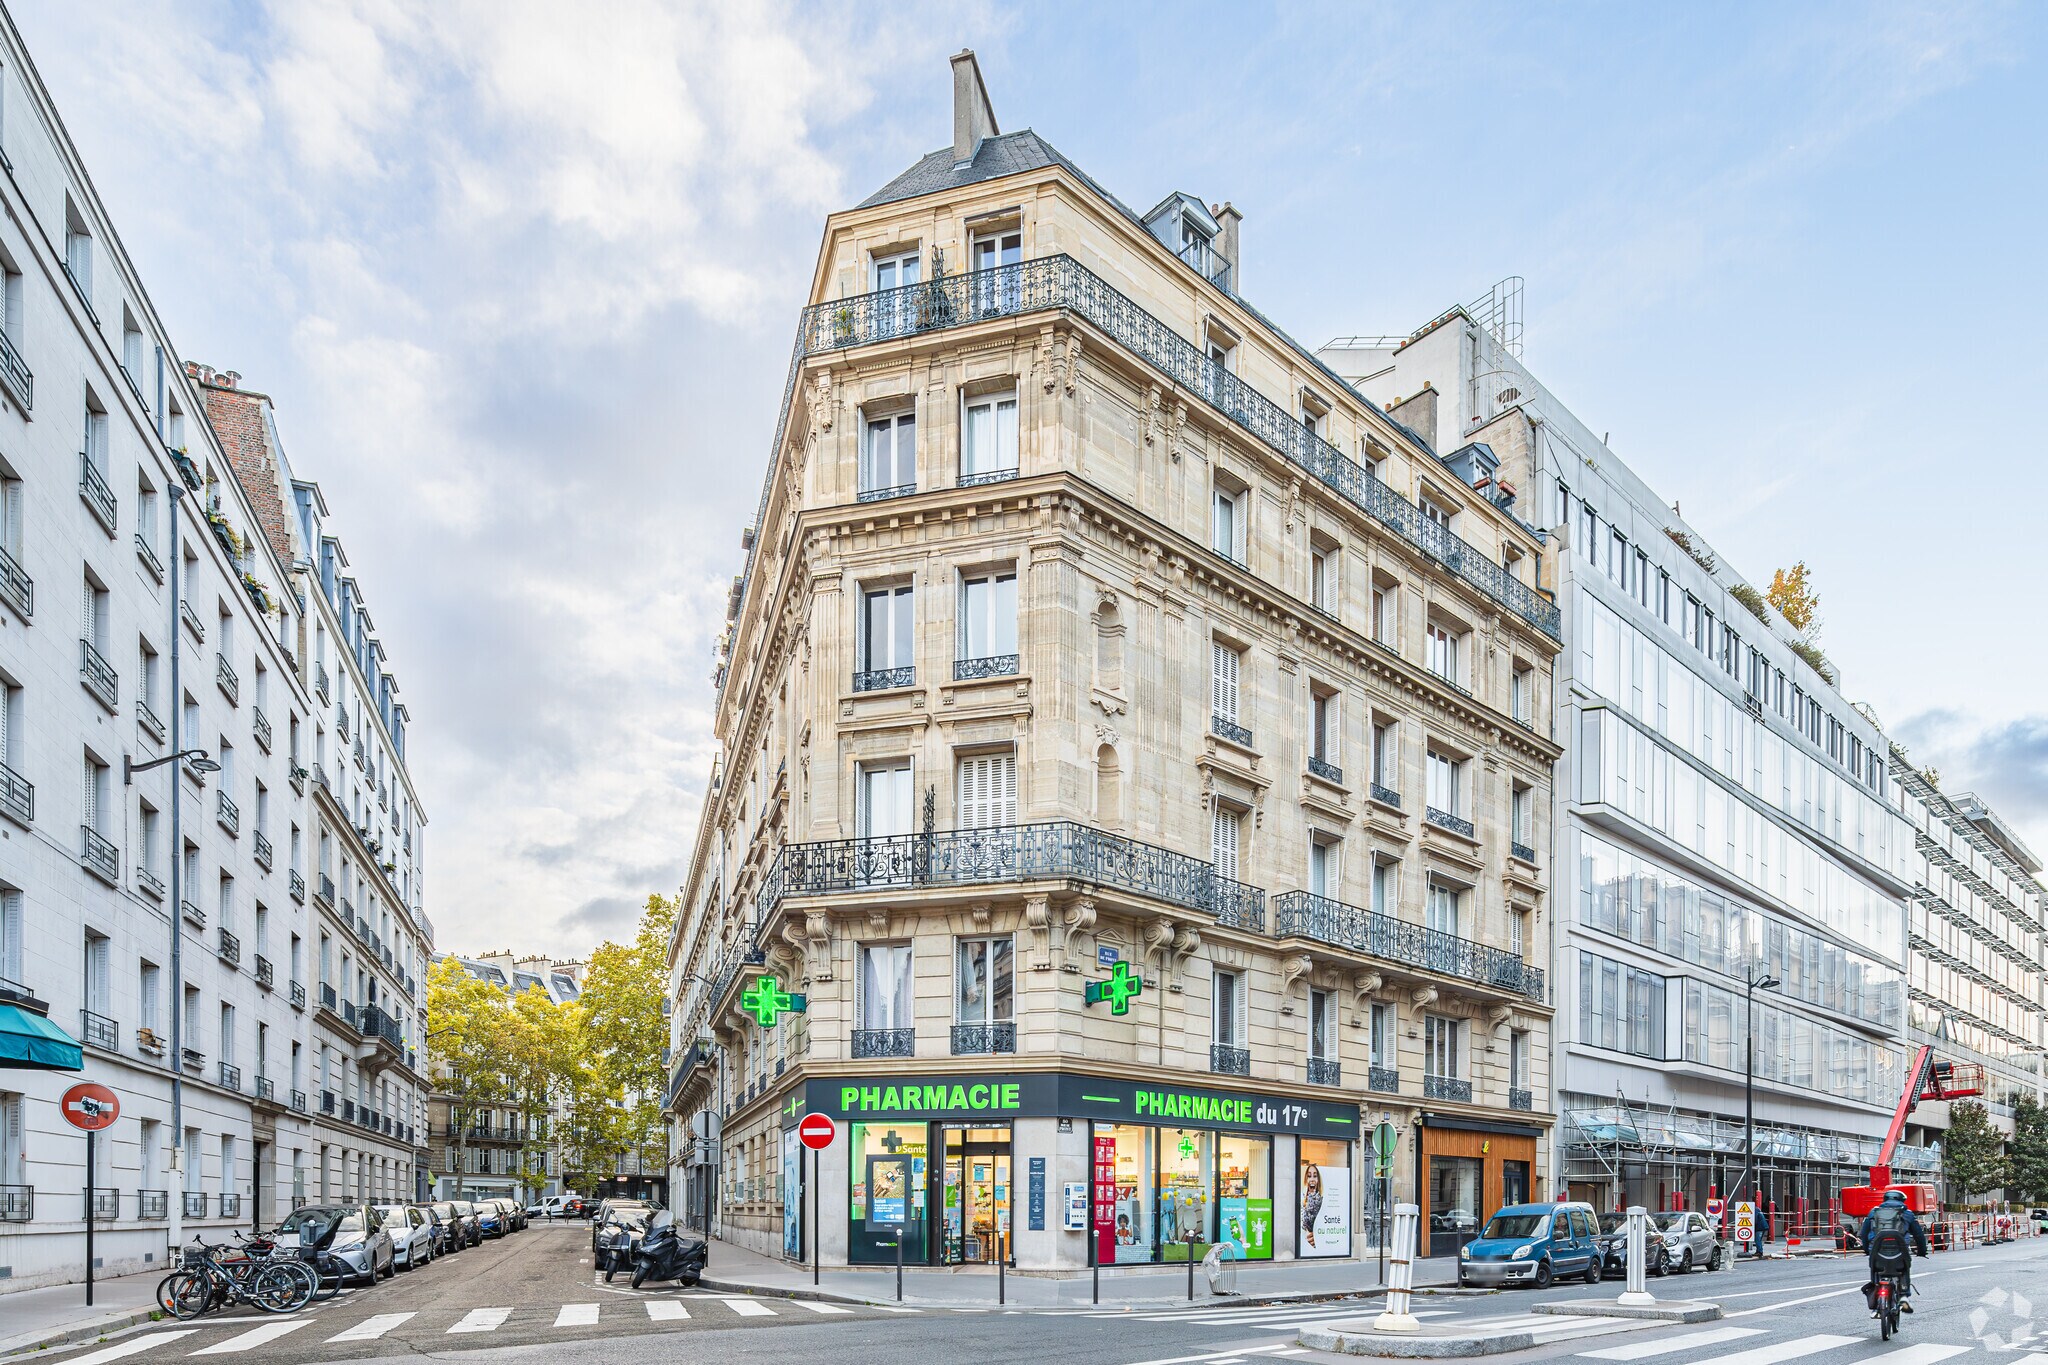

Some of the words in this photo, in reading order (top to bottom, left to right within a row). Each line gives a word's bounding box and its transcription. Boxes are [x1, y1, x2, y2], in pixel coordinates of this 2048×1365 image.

[841, 1083, 1020, 1111] PHARMACIE
[1135, 1090, 1252, 1123] PHARMACIE
[1256, 1102, 1277, 1125] du
[902, 1145, 927, 1154] Santé
[1324, 1214, 1341, 1224] Santé
[1327, 1225, 1347, 1235] naturel
